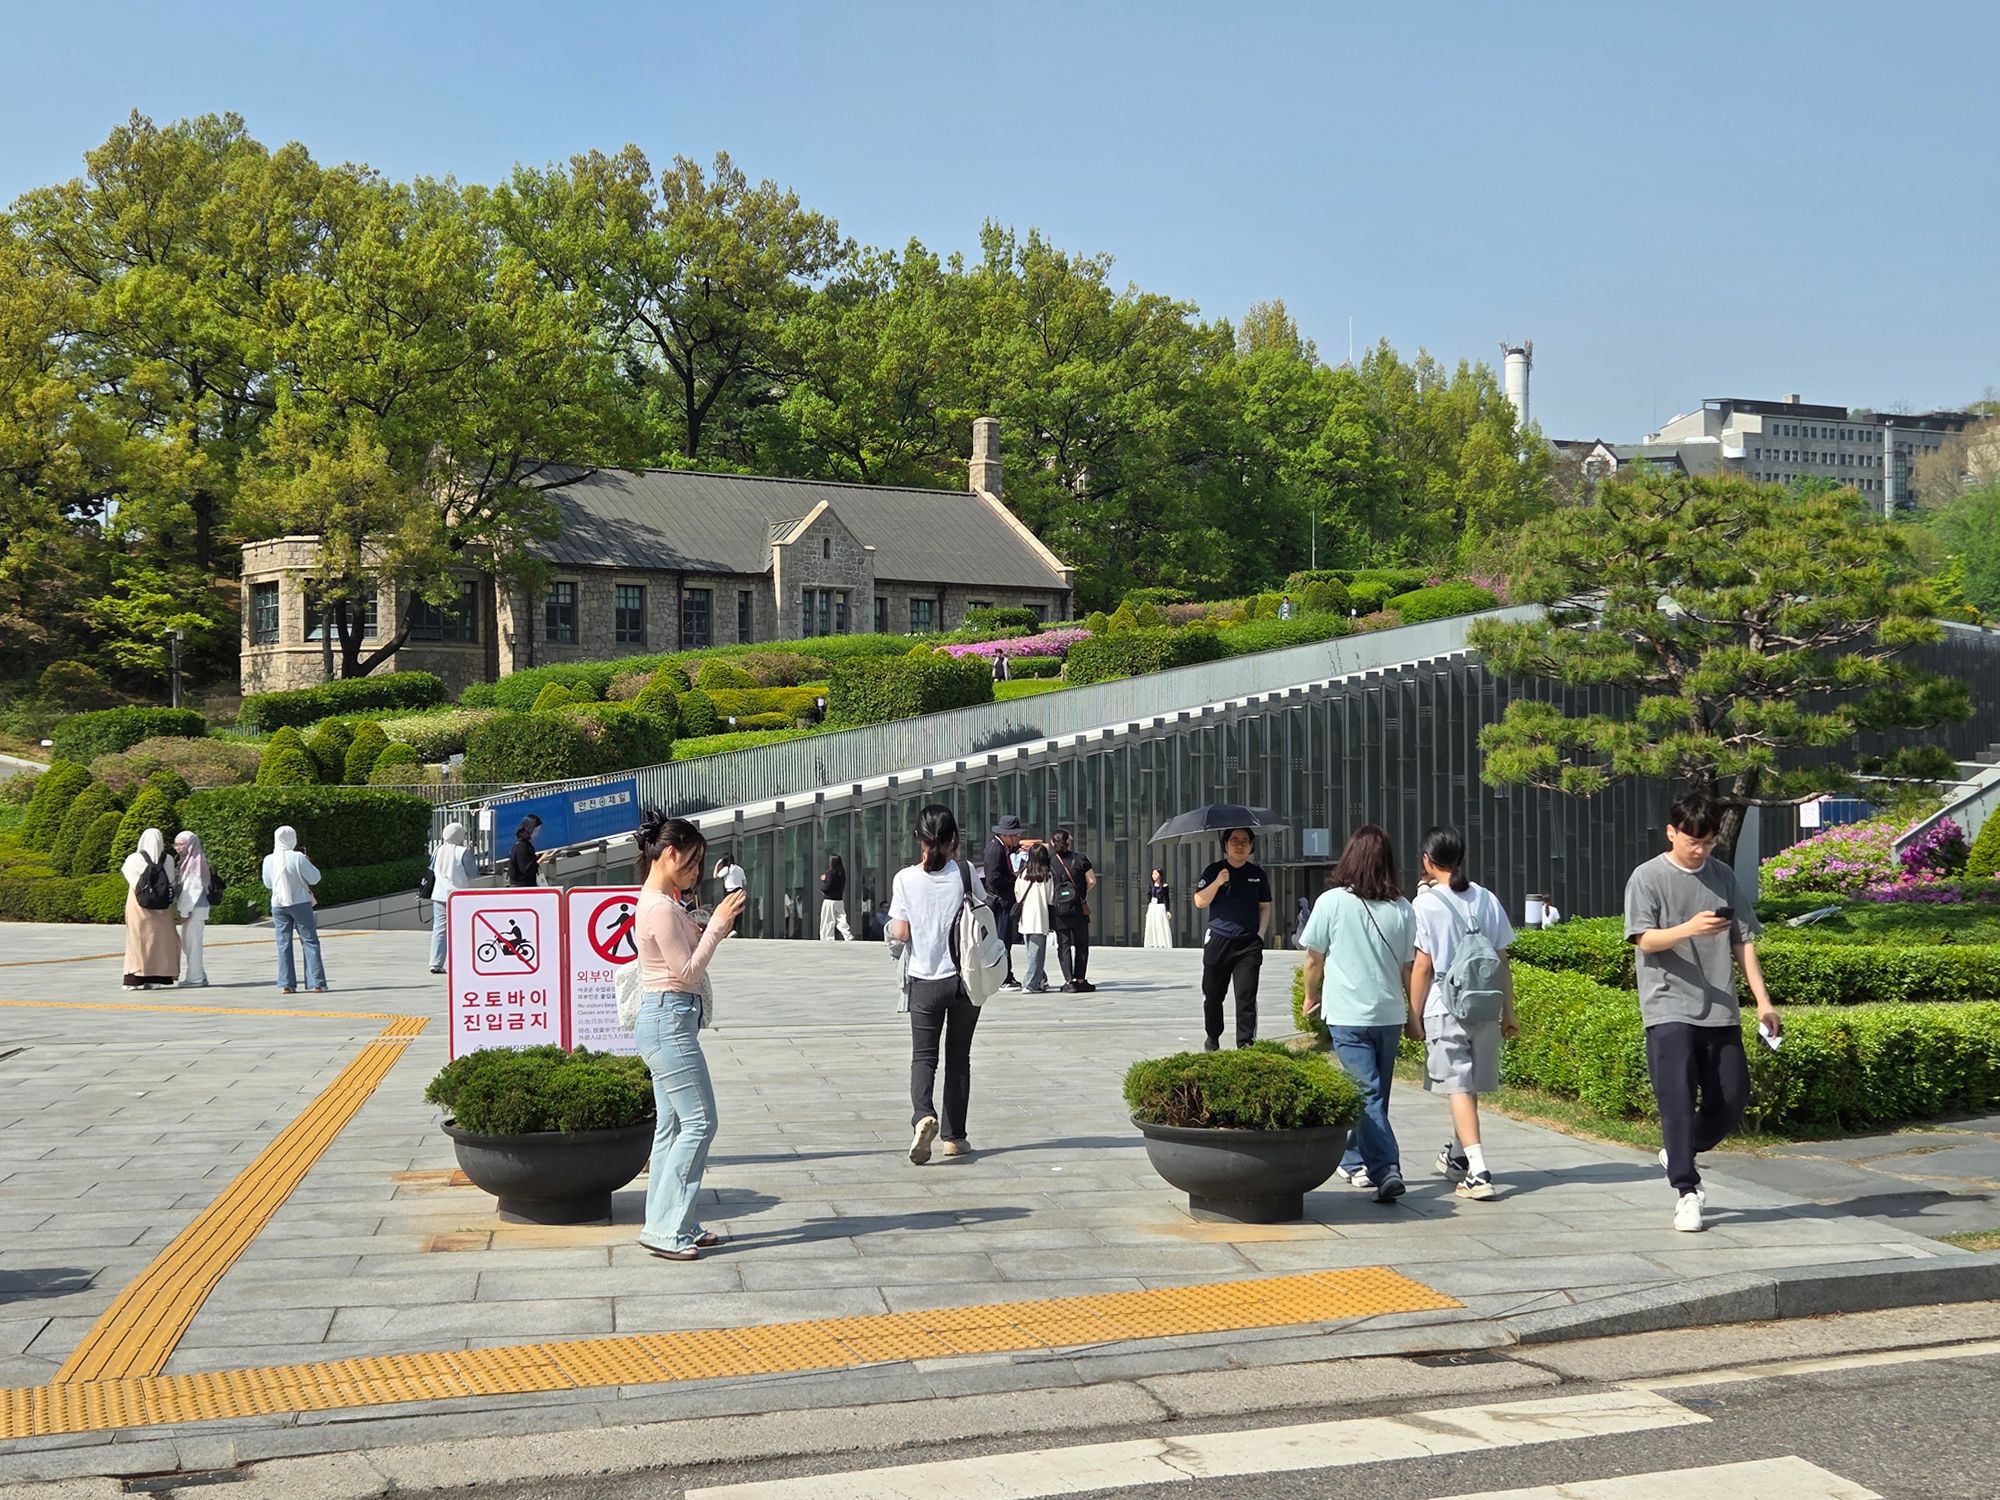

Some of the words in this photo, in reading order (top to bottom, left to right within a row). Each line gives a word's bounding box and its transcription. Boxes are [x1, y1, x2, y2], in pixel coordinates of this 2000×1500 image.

[578, 800, 597, 811] 안전
[608, 793, 626, 804] 제일
[1311, 831, 1319, 853] 1
[577, 969, 614, 983] 외부인
[462, 989, 547, 1008] 오토바이
[463, 1012, 548, 1031] 진입금지
